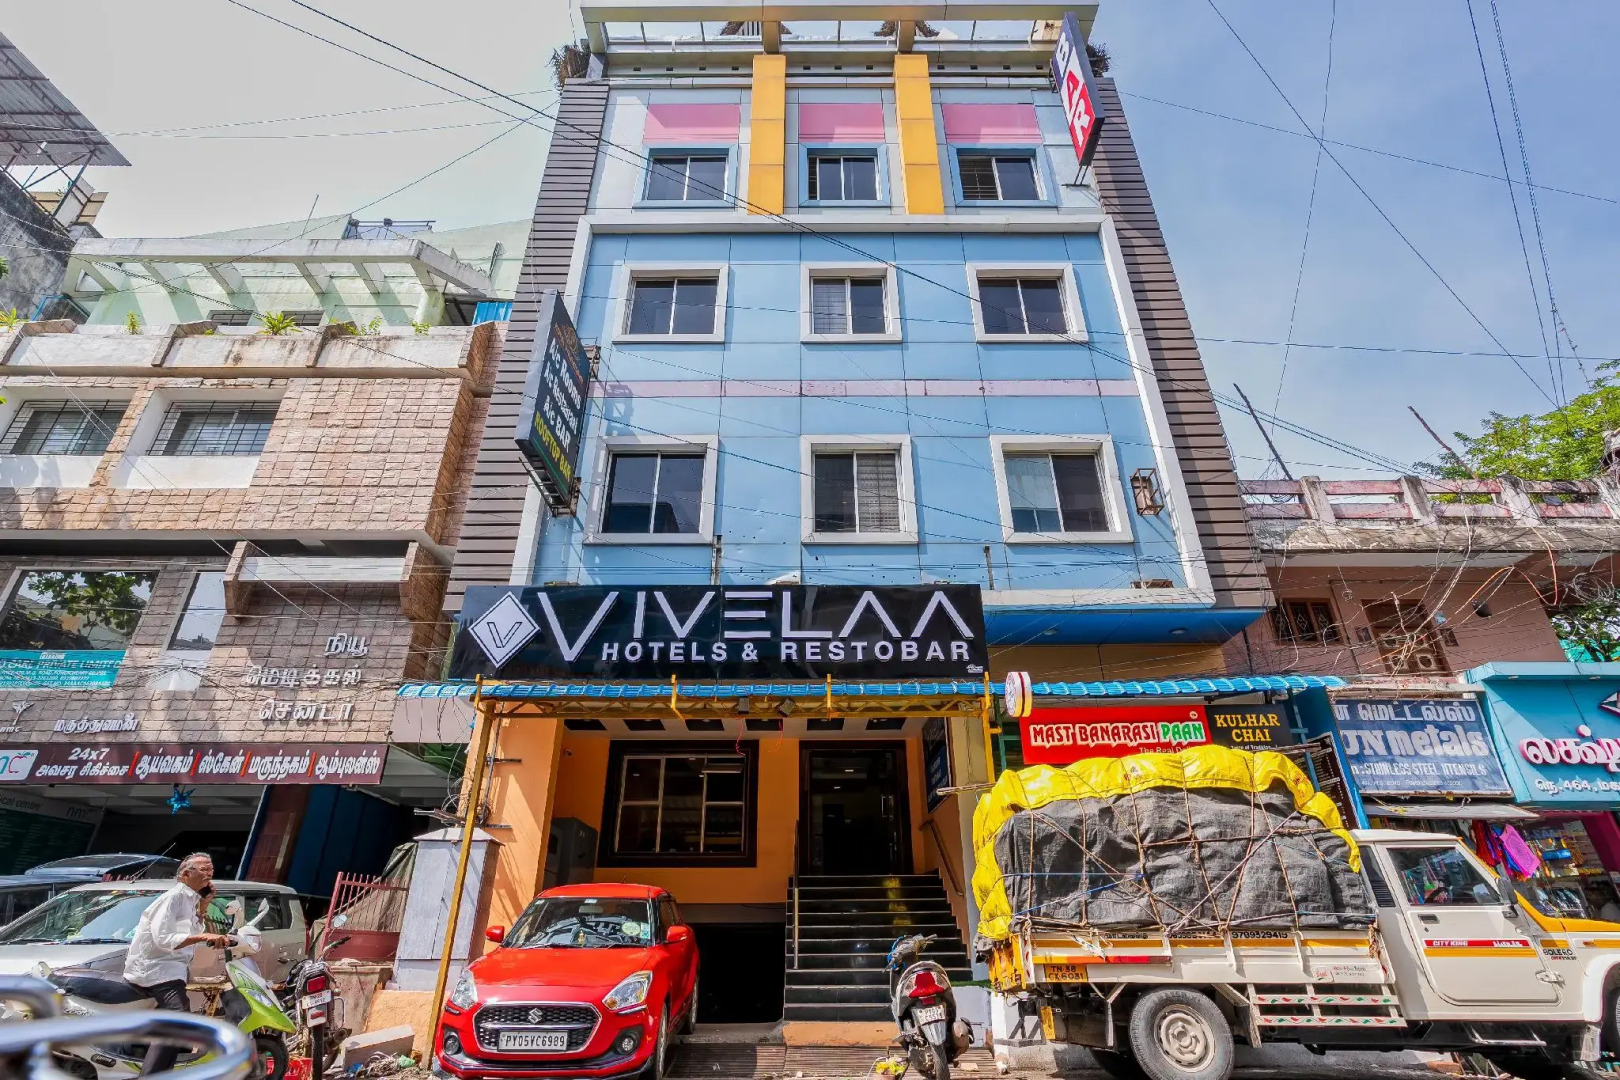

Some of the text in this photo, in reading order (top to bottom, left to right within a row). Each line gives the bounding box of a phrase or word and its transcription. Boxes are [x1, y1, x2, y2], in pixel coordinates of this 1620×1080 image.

[1055, 32, 1091, 146] BAR
[534, 411, 571, 482] ROOFTOP BAR
[556, 415, 571, 453] BAR
[538, 591, 975, 662] VIVELAA
[601, 641, 970, 662] HOTELS & RESTOBAR
[1214, 714, 1280, 728] KULHAR
[1031, 721, 1206, 748] MAST BANARASI PAAN
[1231, 729, 1272, 742] CHAI
[1386, 724, 1490, 757] metals
[68, 747, 110, 760] 24x7
[198, 749, 244, 774] ஸ்கேன்
[248, 750, 310, 780] மருந்தகம்
[35, 761, 129, 780] அவசர சிகிச்சை
[1414, 763, 1440, 776] STEEL
[1442, 764, 1487, 776] UTENSILS
[505, 1035, 565, 1047] PY05VC6989
